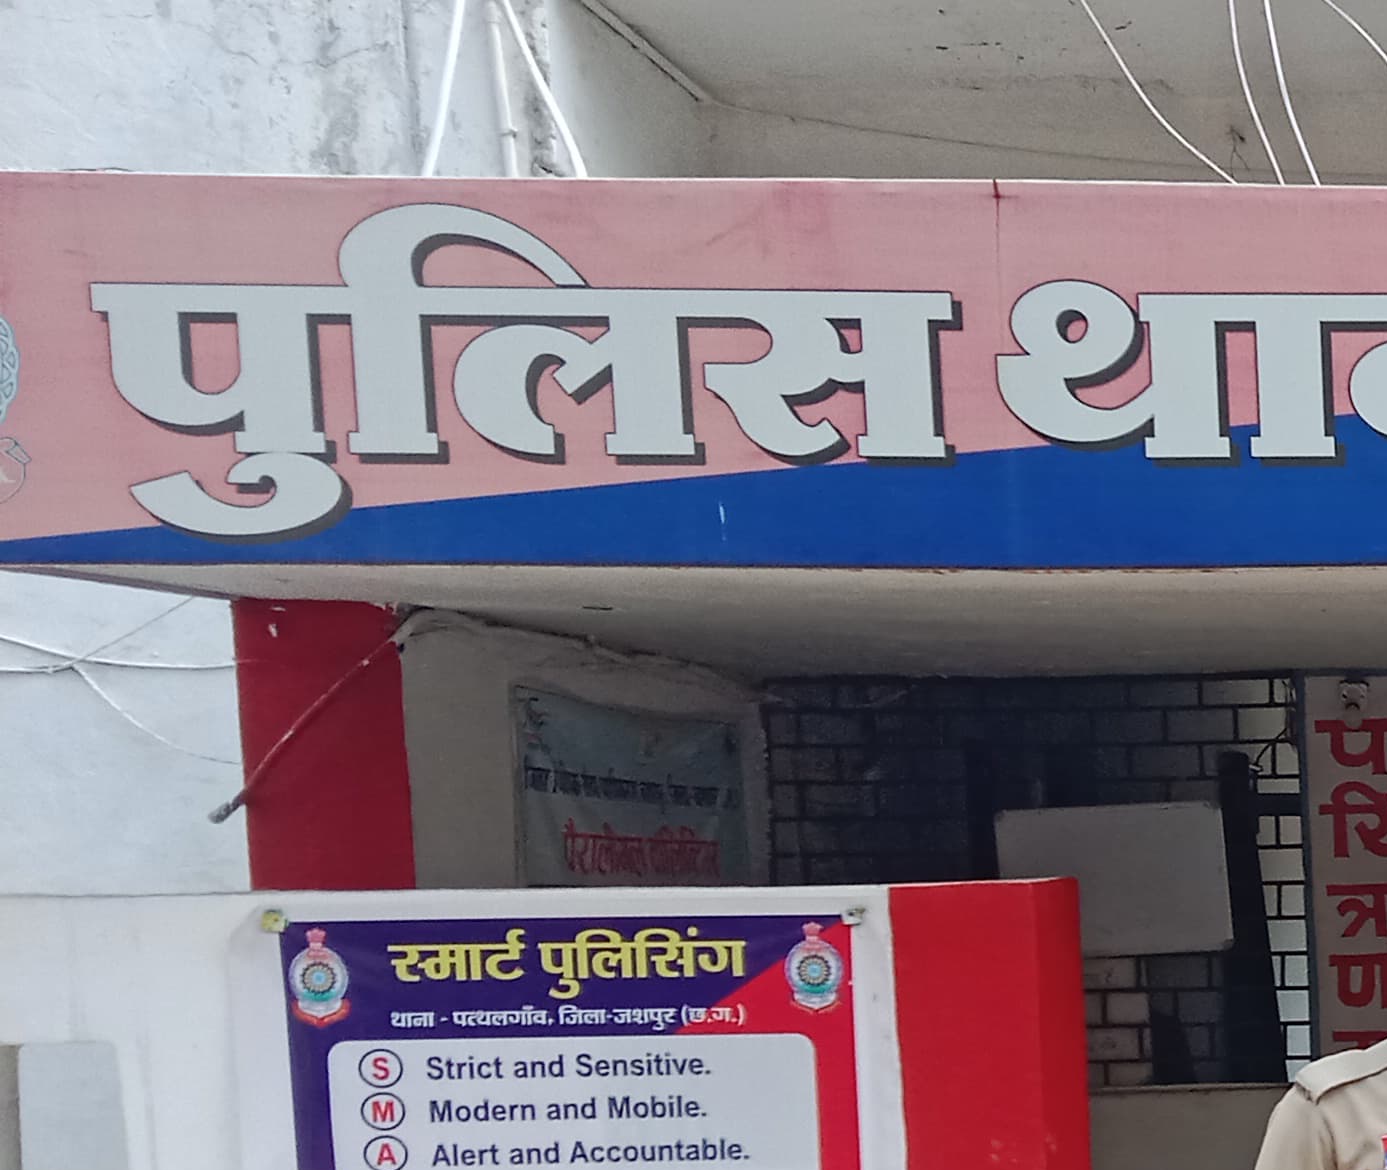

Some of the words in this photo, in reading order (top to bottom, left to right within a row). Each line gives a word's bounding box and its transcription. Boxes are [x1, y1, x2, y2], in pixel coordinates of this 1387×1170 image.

[90, 202, 956, 537] पुलिस
[387, 929, 526, 981] स्मार्ट
[538, 927, 746, 999] पुलिसिंग
[390, 1011, 435, 1028] थाना
[558, 1006, 676, 1031] जिला-जशपुर
[681, 1005, 746, 1026] (छ.ग.)
[372, 1057, 390, 1080] S
[426, 1056, 504, 1081] Strict
[513, 1054, 565, 1078] and
[575, 1053, 712, 1077] Sensitive.
[371, 1100, 396, 1123] M
[429, 1099, 536, 1123] Modern
[546, 1096, 597, 1120] and
[608, 1095, 707, 1119] Mobile.
[376, 1143, 397, 1166] A
[432, 1144, 500, 1167] Alert
[509, 1142, 560, 1165] and
[570, 1138, 750, 1163] Accountable.
